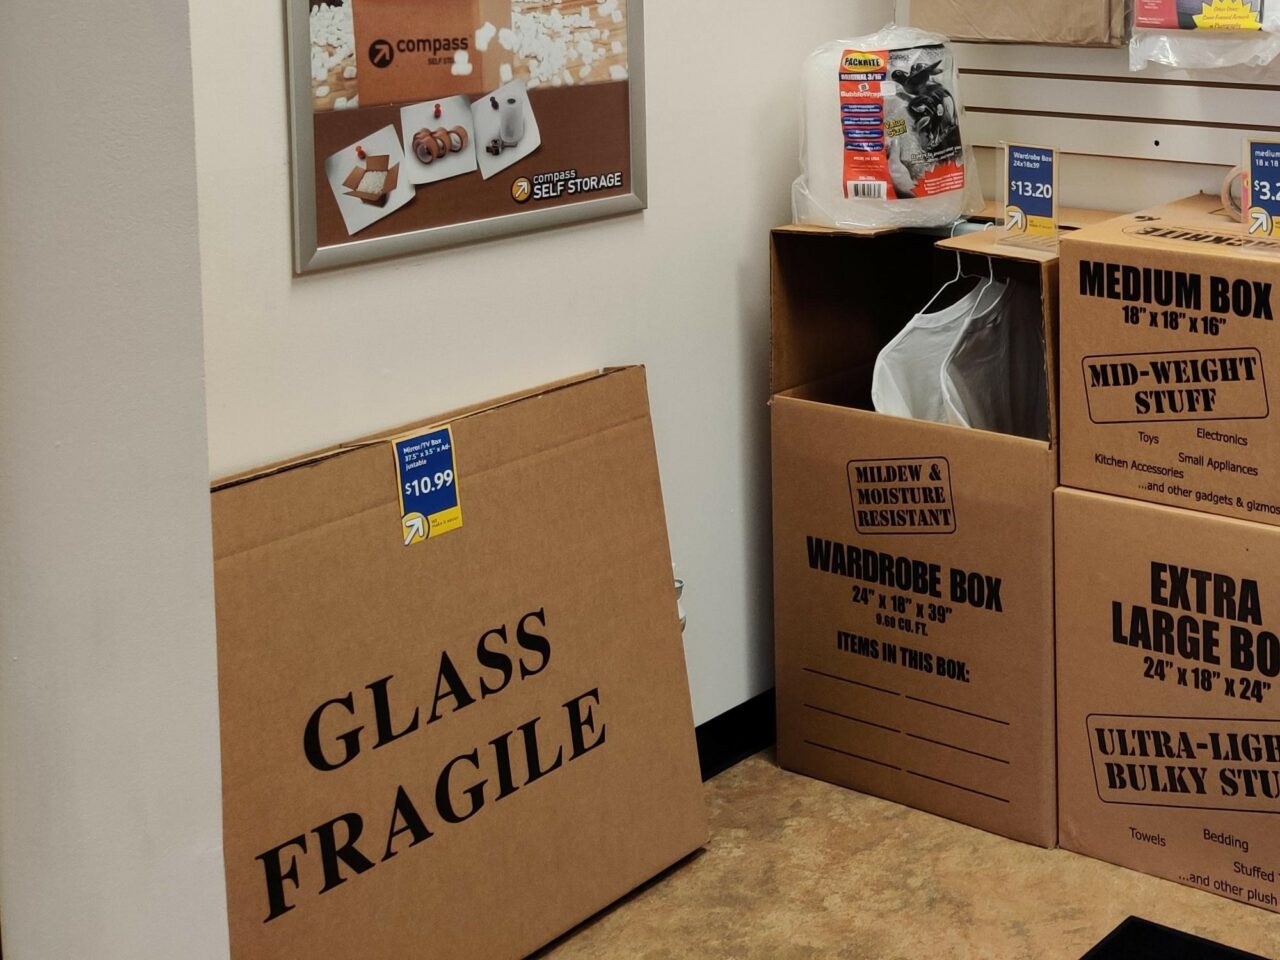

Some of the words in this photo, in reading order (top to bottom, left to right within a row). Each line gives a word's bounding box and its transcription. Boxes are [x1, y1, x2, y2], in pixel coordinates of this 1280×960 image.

[397, 37, 469, 56] compass
[844, 56, 882, 68] PACKRITE
[1013, 151, 1041, 161] Wardrobe
[1254, 149, 1280, 158] medium
[533, 169, 576, 185] compass
[533, 183, 565, 199] SELF
[567, 172, 622, 193] STORAGE
[1010, 180, 1052, 199] $13.20
[1079, 260, 1201, 311] MEDIUM
[1210, 275, 1273, 320] BOX
[1088, 357, 1257, 387] MID-WEIGHT
[1134, 388, 1217, 415] STUFF
[403, 440, 431, 454] Mirror/TV
[431, 438, 442, 447] Box
[1138, 430, 1160, 445] Toys
[1196, 427, 1248, 446] Electronics
[855, 464, 923, 483] MILDEW
[928, 463, 941, 481] &
[1094, 453, 1128, 470] Kitchen
[1130, 459, 1184, 479] Accessories
[1178, 452, 1204, 467] Small
[1207, 457, 1258, 477] Appliances
[405, 469, 453, 497] $10.99
[858, 486, 946, 505] MOISTURE
[1167, 484, 1192, 498] other
[1195, 489, 1233, 508] gadgets
[1236, 494, 1244, 508] &
[857, 508, 952, 527] RESISTANT
[806, 535, 942, 598] WARDROBE
[950, 568, 1003, 612] BOX
[1150, 560, 1263, 626] EXTRA
[1112, 600, 1220, 665] LARGE
[302, 606, 552, 772] GLASS
[1104, 761, 1208, 795] BULKY
[254, 687, 607, 924] FRAGILE
[1129, 826, 1166, 847] Towels
[1203, 828, 1249, 853] Bedding
[1233, 860, 1275, 884] Stuffed
